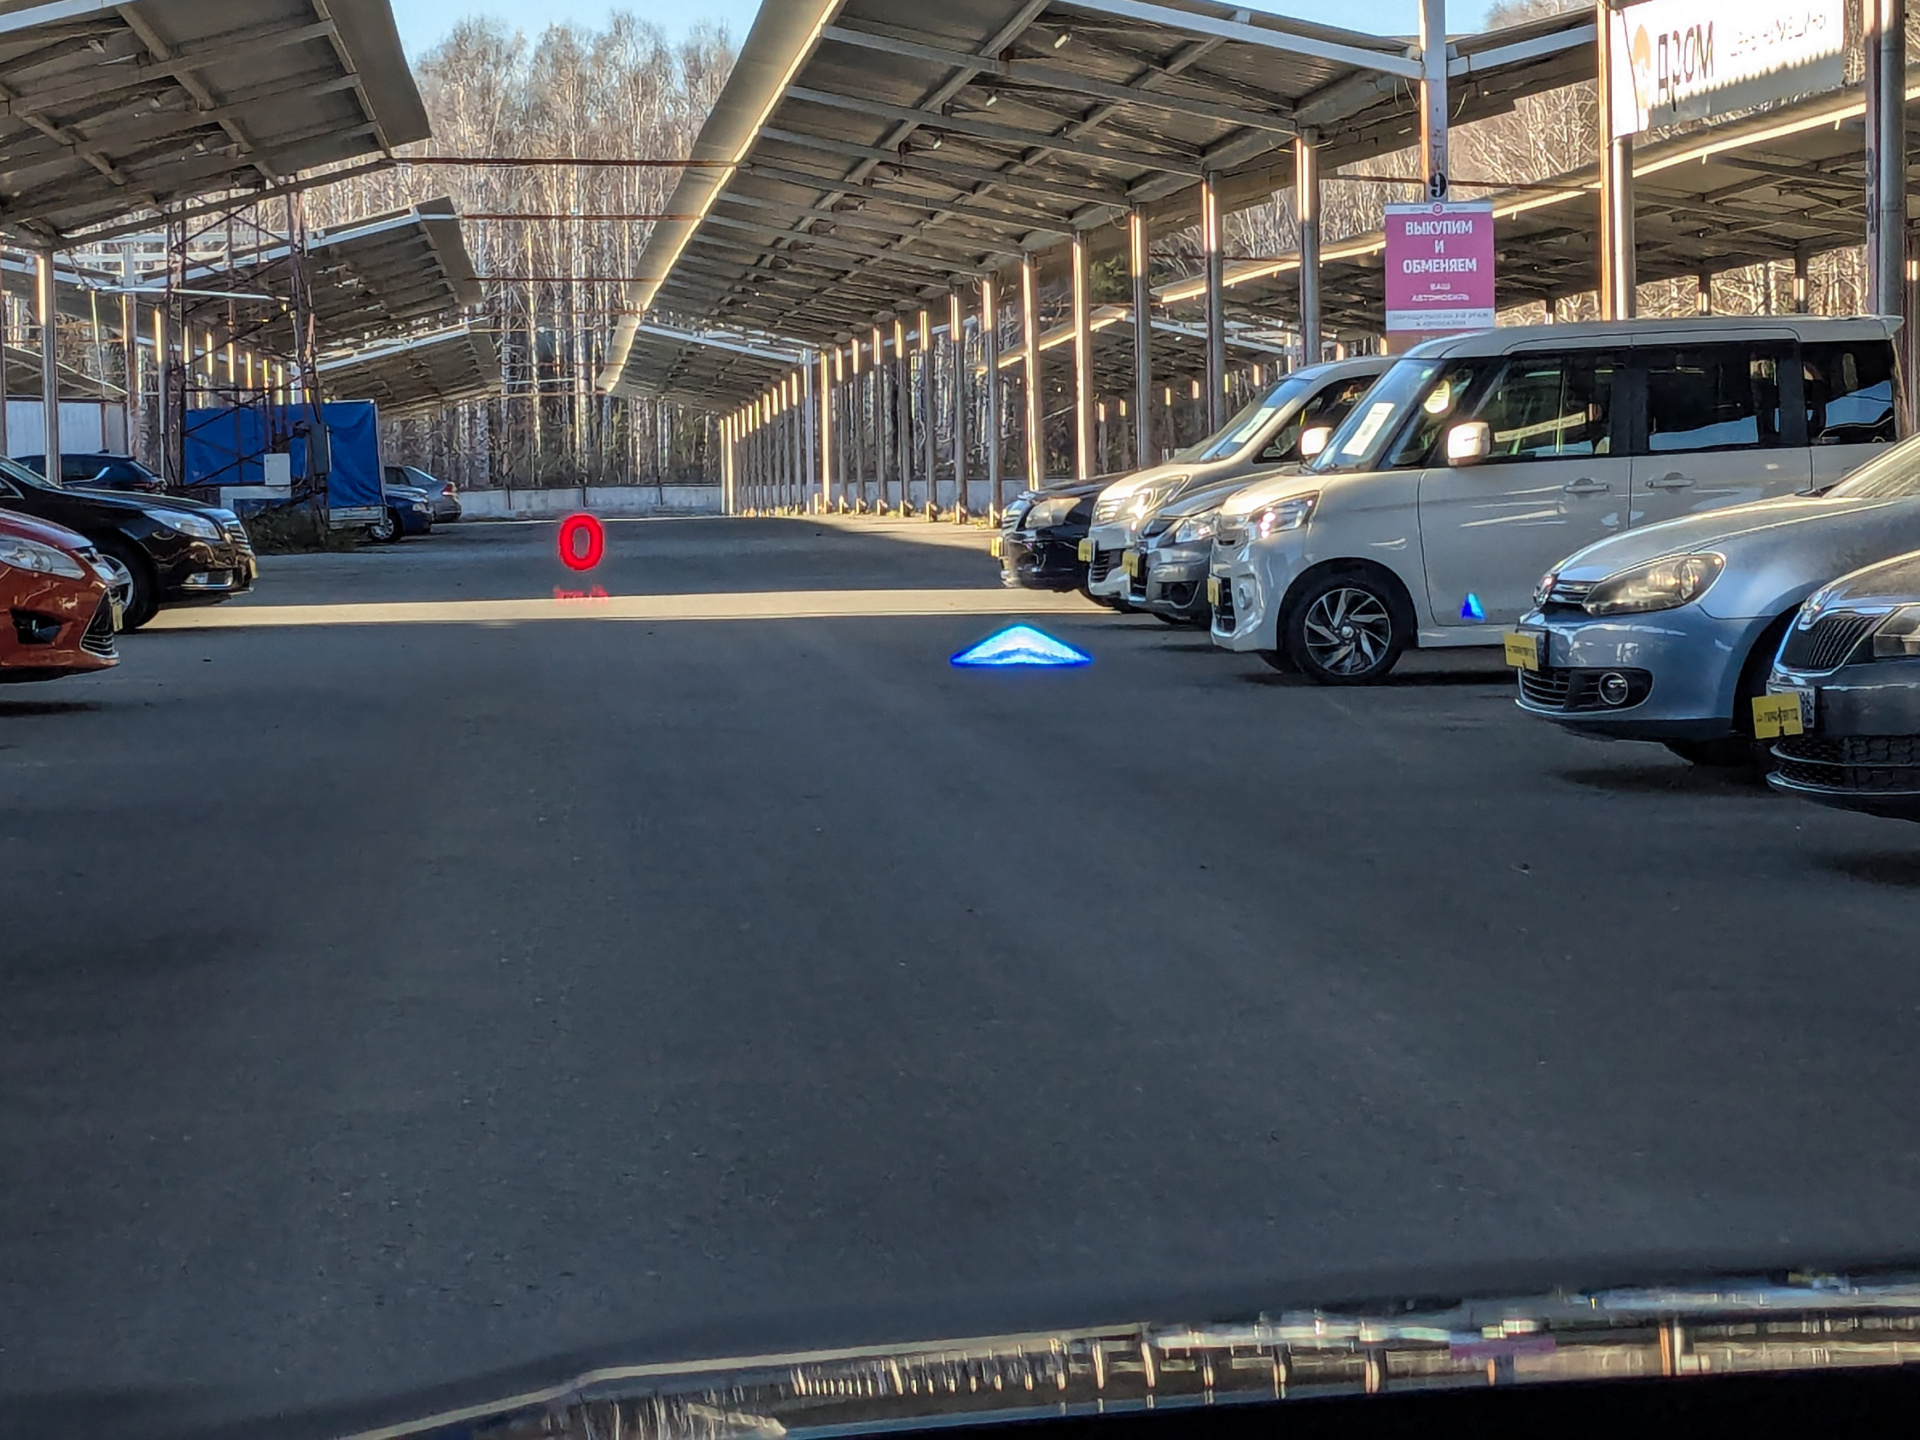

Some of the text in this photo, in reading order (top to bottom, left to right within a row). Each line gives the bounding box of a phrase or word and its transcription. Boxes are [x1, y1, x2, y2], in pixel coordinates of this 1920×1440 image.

[1429, 172, 1447, 198] 9
[1405, 220, 1473, 236] ВЫКУПИМ
[1434, 240, 1445, 254] И
[1403, 258, 1477, 273] ОБМЕНЯЕМ
[558, 513, 604, 572] 0
